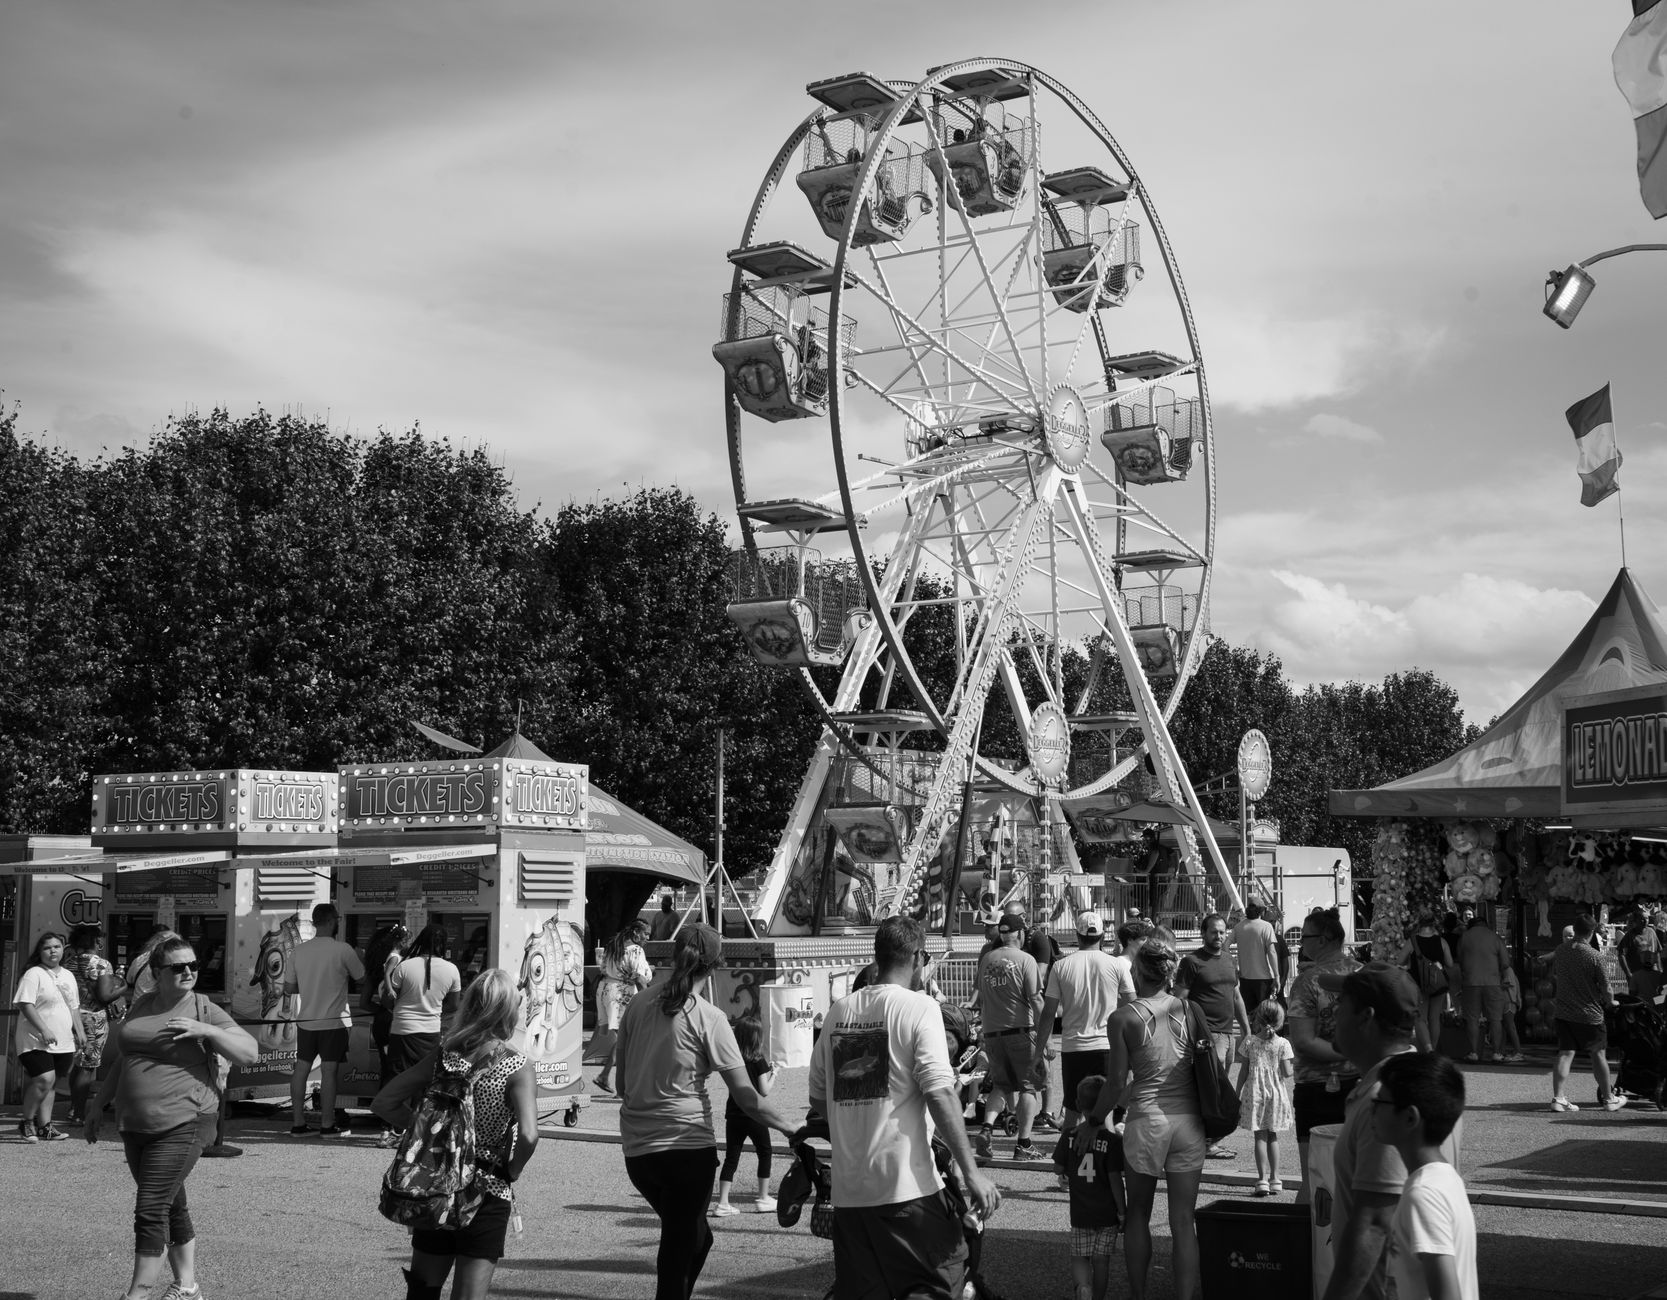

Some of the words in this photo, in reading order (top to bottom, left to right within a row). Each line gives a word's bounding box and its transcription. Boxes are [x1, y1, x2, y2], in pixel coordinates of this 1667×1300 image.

[1573, 713, 1667, 788] LEMONAD
[114, 782, 219, 823] TICKETS
[256, 782, 323, 820] TICKETS
[356, 772, 485, 817] TICKETS
[516, 773, 577, 816] TICKETS
[144, 856, 205, 868] Deggeller.com
[262, 859, 303, 867] Welcome
[334, 857, 356, 865] Fair!
[416, 849, 473, 860] Deggeller.com
[60, 889, 102, 927] Gu
[344, 1068, 380, 1082] America
[535, 1061, 568, 1073] ller.com
[1069, 1137, 1108, 1153] TER
[1077, 1152, 1097, 1183] 4
[1244, 1261, 1282, 1271] RECYCLE
